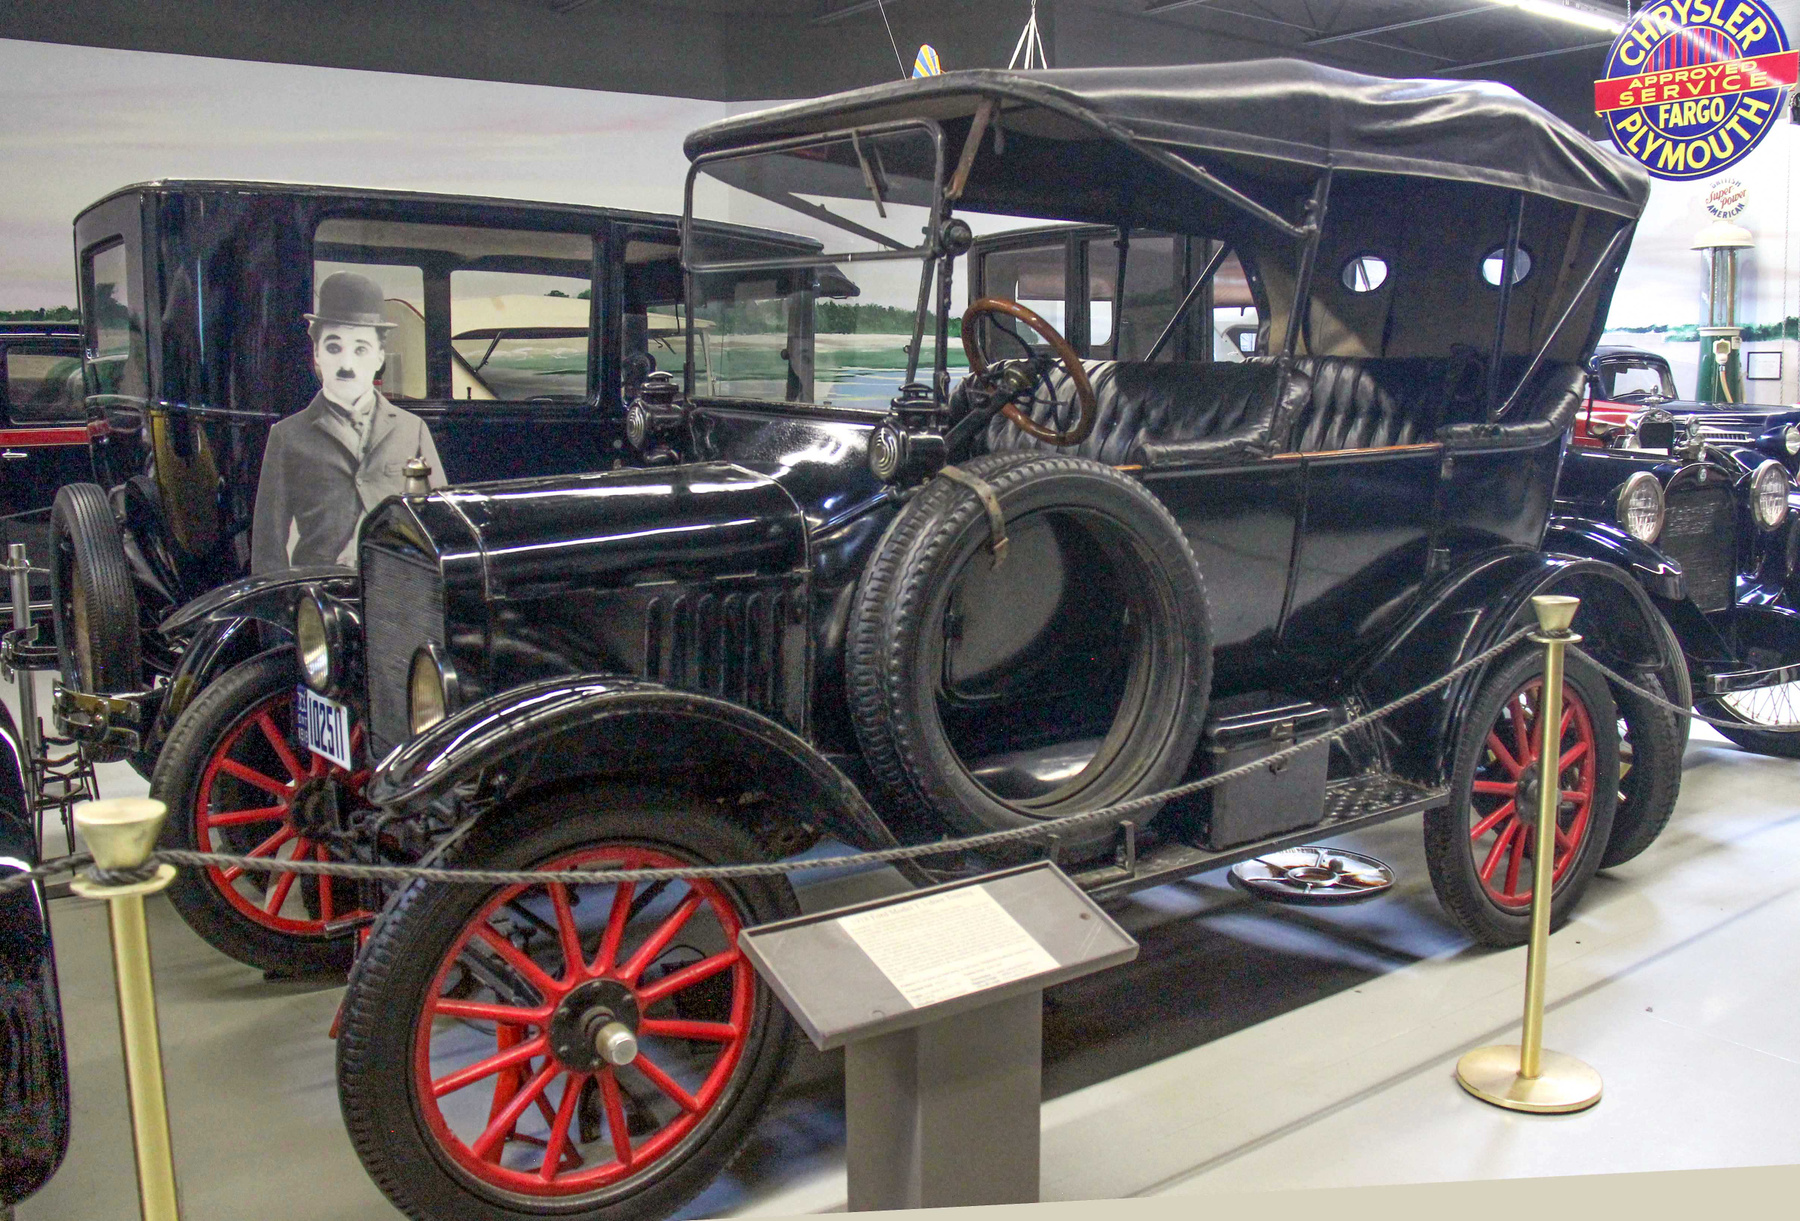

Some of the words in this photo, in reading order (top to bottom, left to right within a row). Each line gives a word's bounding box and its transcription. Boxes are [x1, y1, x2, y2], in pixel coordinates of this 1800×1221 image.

[1620, 0, 1768, 66] CHRYSLER
[1619, 71, 1768, 106] SERVICE
[1628, 60, 1758, 90] APPROVED
[1659, 97, 1725, 129] FARGO
[1616, 96, 1771, 171] PLYMOUTH
[1706, 203, 1745, 219] AMERICAN
